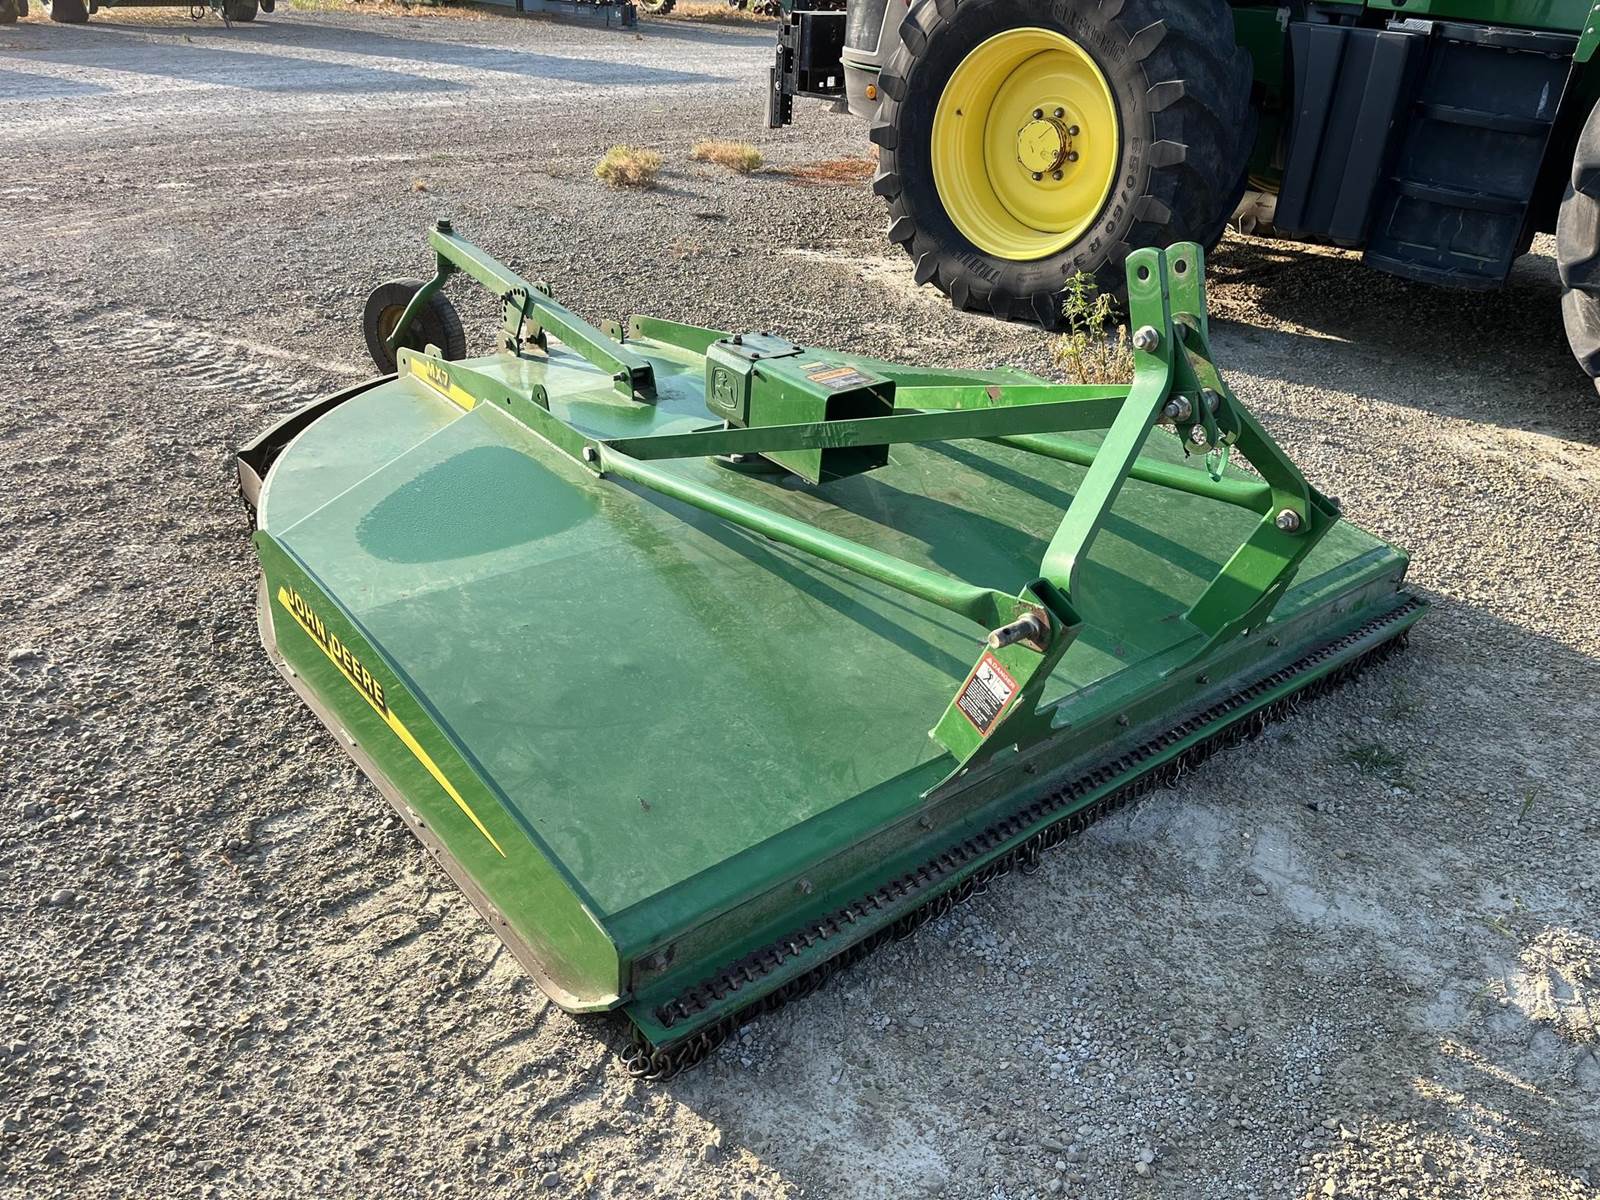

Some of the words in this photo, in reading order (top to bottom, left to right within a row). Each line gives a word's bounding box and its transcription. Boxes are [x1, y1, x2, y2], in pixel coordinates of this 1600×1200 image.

[426, 360, 450, 387] MX7
[286, 584, 329, 646] JOHN
[328, 631, 386, 709] DEERE
